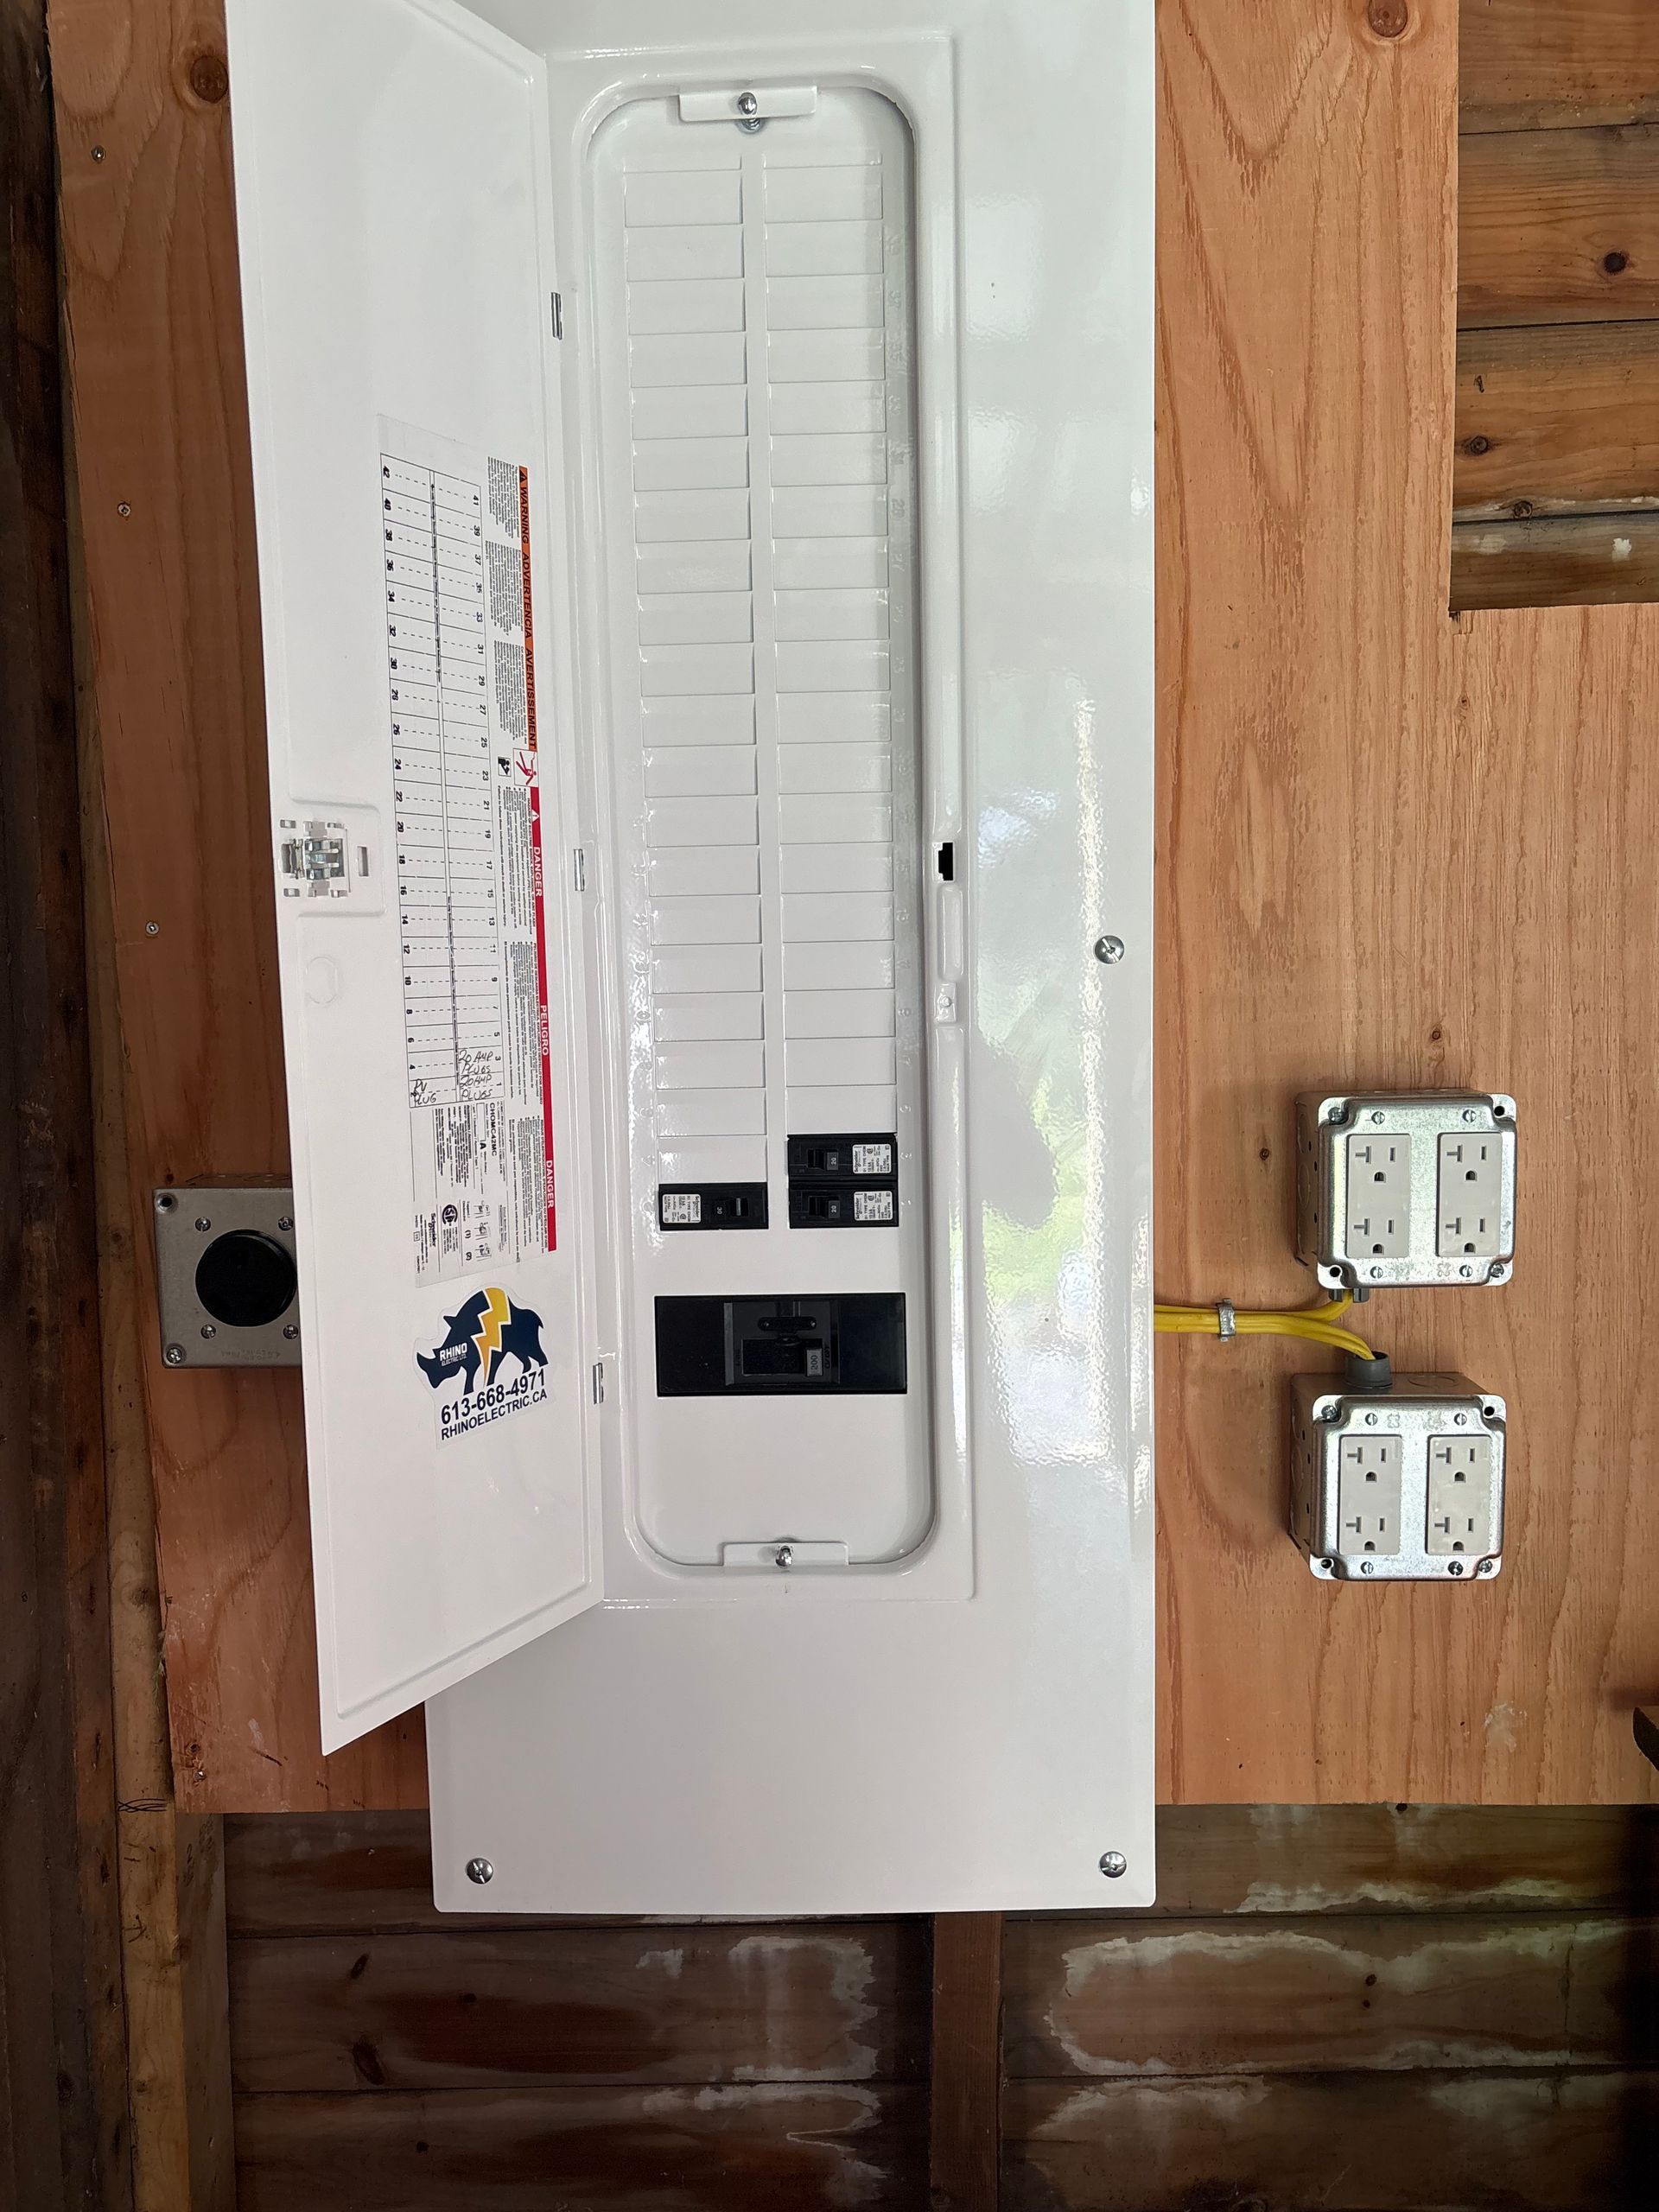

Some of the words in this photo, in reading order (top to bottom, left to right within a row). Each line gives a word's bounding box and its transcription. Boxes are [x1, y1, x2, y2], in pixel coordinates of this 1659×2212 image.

[382, 465, 390, 478] 42
[384, 498, 391, 511] 40
[473, 494, 479, 505] 41
[519, 486, 529, 543] WARNING
[385, 528, 392, 541] 38
[474, 524, 480, 536] 39
[386, 558, 393, 571] 36
[474, 554, 481, 565] 37
[387, 590, 395, 601] 34
[522, 551, 531, 638] ADVERTENCIA
[476, 611, 483, 622] 33
[389, 624, 396, 637] 32
[477, 644, 483, 654] 31
[390, 657, 397, 670] 30
[478, 675, 485, 686] 29
[525, 647, 536, 749] AVERTISSEMENT
[479, 704, 486, 715] 27
[392, 723, 400, 735] 26
[480, 736, 487, 747] 25
[394, 758, 401, 769] 24
[482, 770, 488, 780] 23
[395, 790, 403, 802] 22
[483, 800, 489, 810] 21
[397, 821, 404, 832] 20
[484, 830, 491, 838] 19
[398, 855, 405, 864] 18
[486, 860, 493, 869] 17
[533, 846, 542, 896] DANGER
[400, 885, 407, 895] 16
[487, 888, 493, 898] 15
[401, 914, 408, 925] 14
[488, 916, 495, 925] 13
[403, 944, 410, 954] 12
[404, 976, 411, 985] 10
[830, 1157, 836, 1166] 20
[545, 1160, 554, 1208] DANGER
[830, 1205, 836, 1213] 20
[439, 1342, 467, 1362] RHINO
[810, 1354, 818, 1370] 200
[441, 1368, 545, 1425] 613-668-4971
[442, 1389, 547, 1440] RHINOELECTRIC.CA
